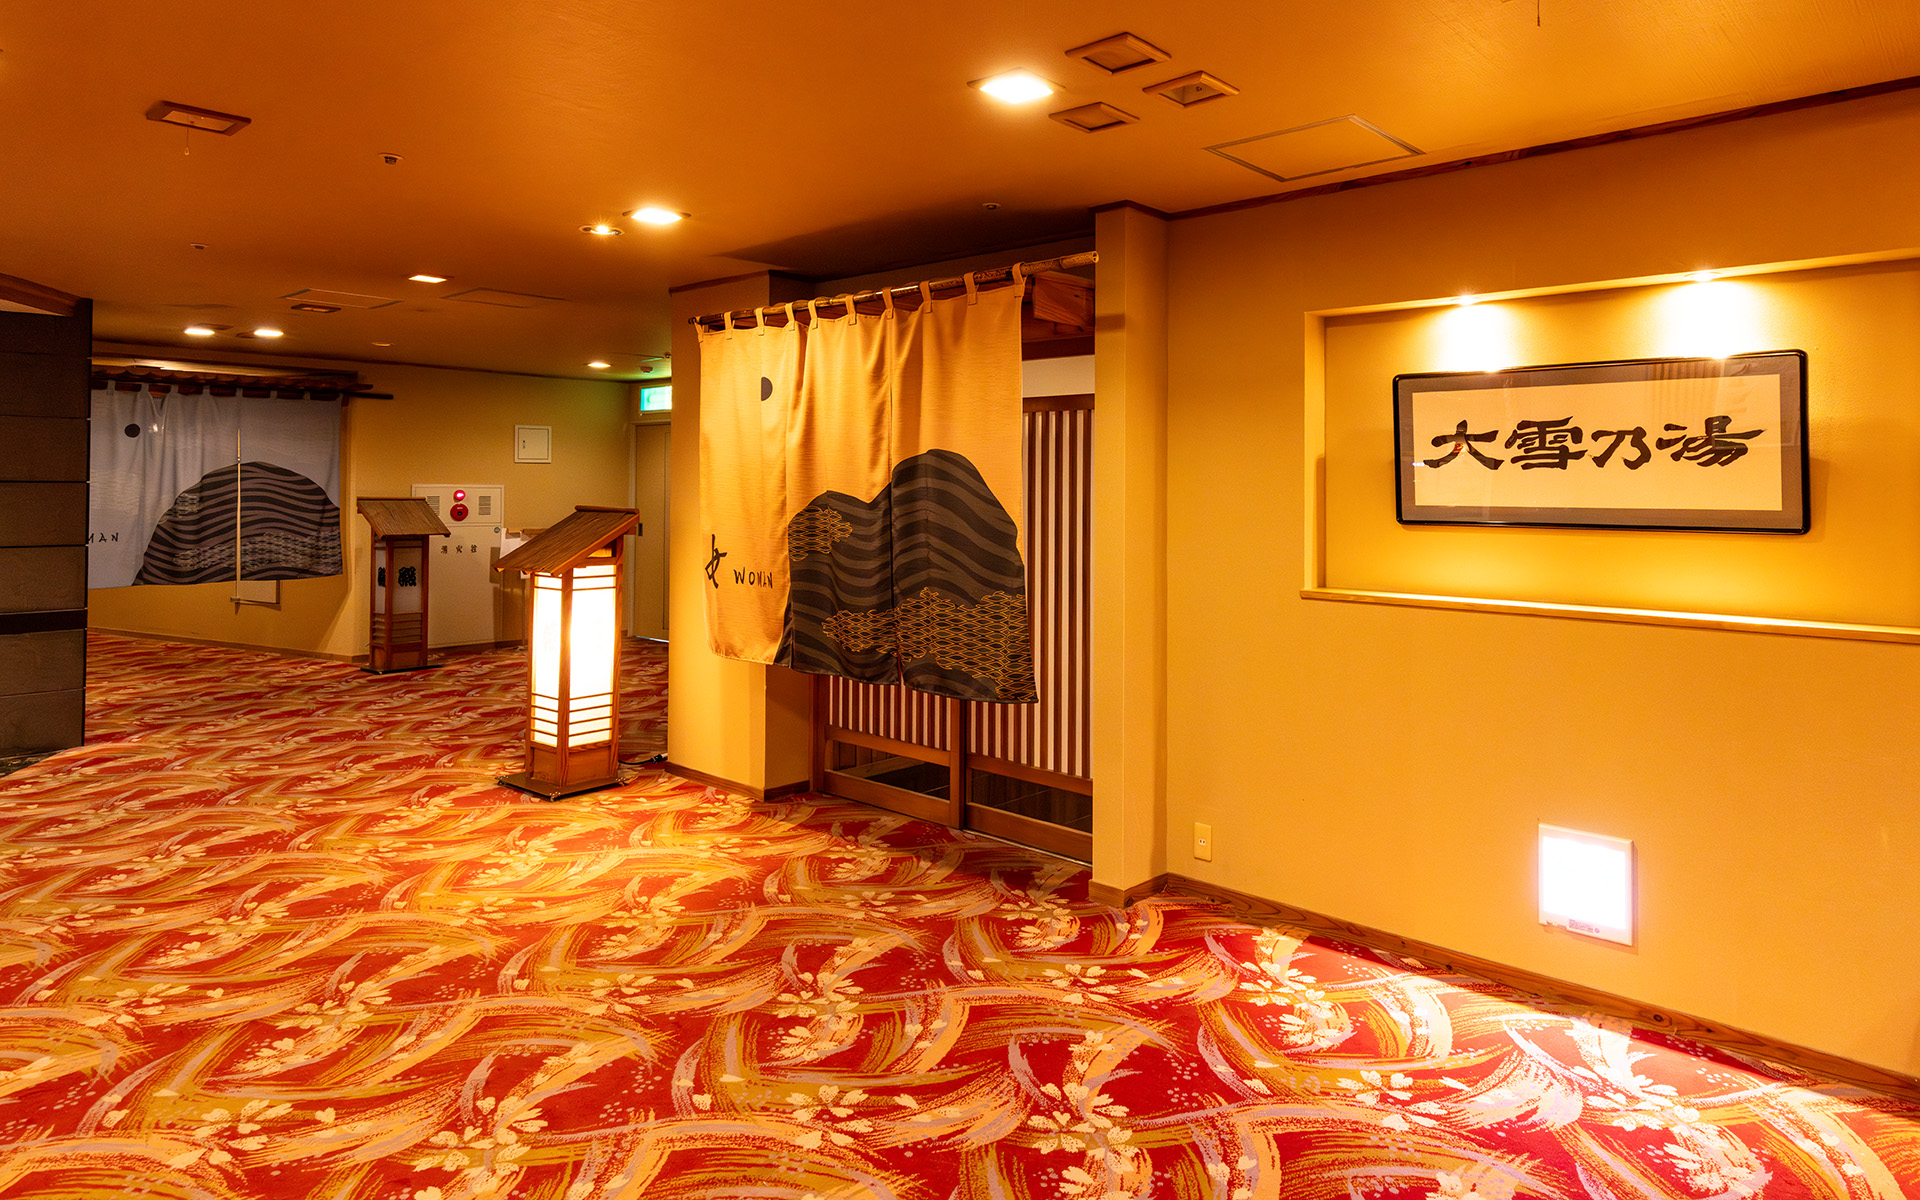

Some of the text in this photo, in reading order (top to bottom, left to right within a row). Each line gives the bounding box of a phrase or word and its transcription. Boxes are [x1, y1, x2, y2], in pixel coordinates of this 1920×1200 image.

[1423, 415, 1767, 470] 大雪乃湯
[705, 534, 727, 589] 女
[733, 567, 773, 589] WOMAN
